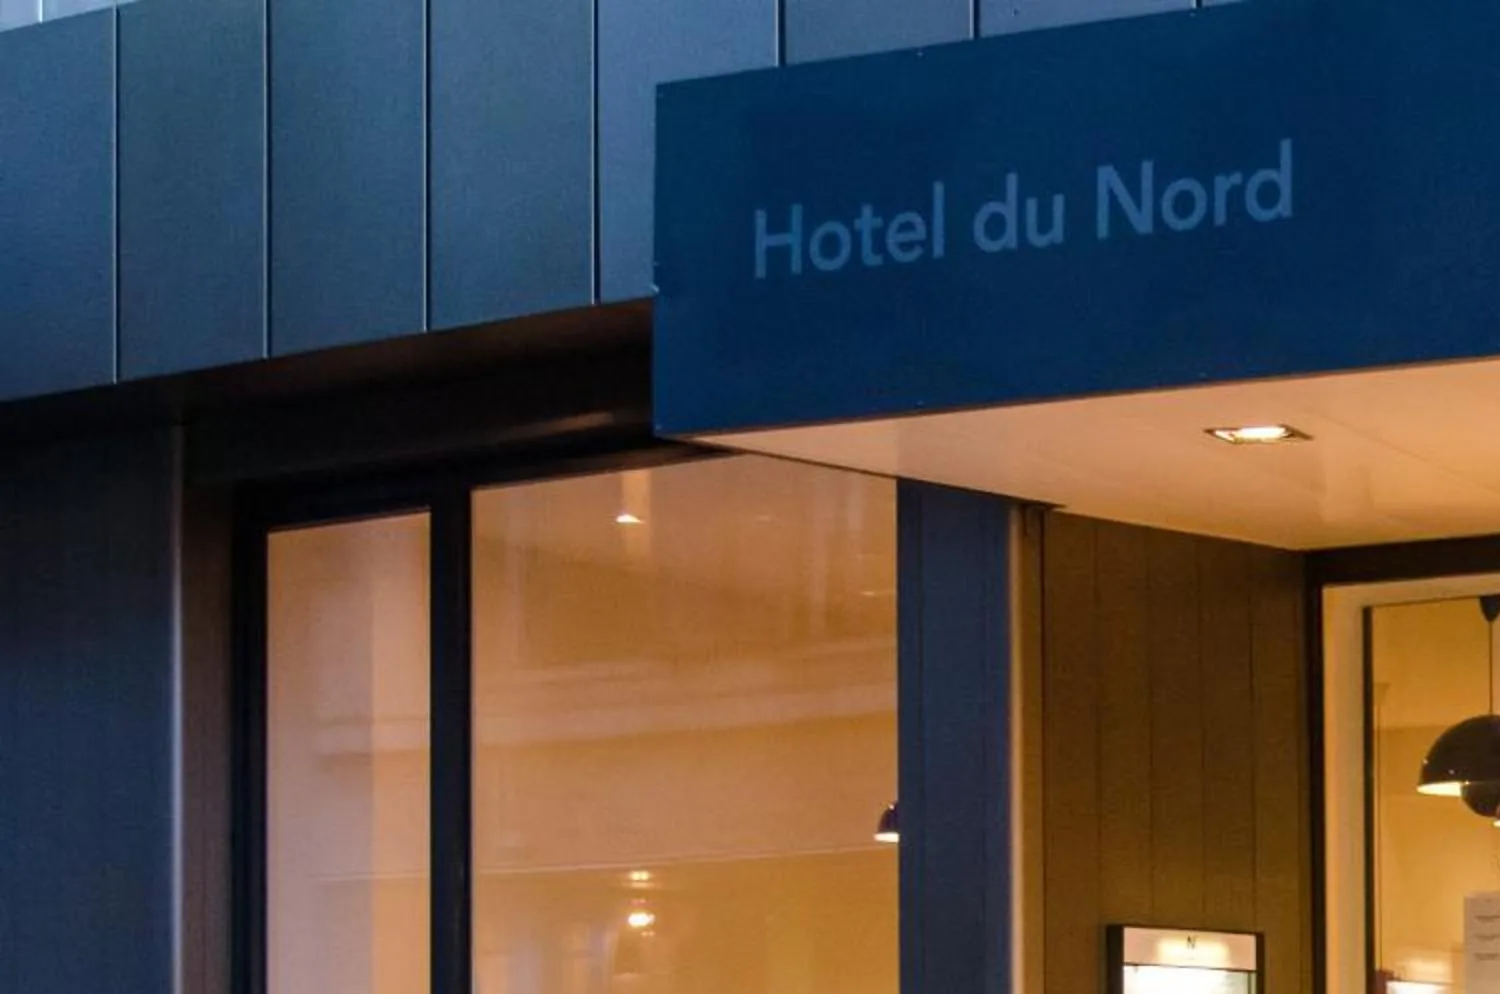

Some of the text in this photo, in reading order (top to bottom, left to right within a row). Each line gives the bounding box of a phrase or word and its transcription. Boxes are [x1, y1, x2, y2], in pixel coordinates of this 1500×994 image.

[754, 137, 1294, 280] Hotel du Nord
